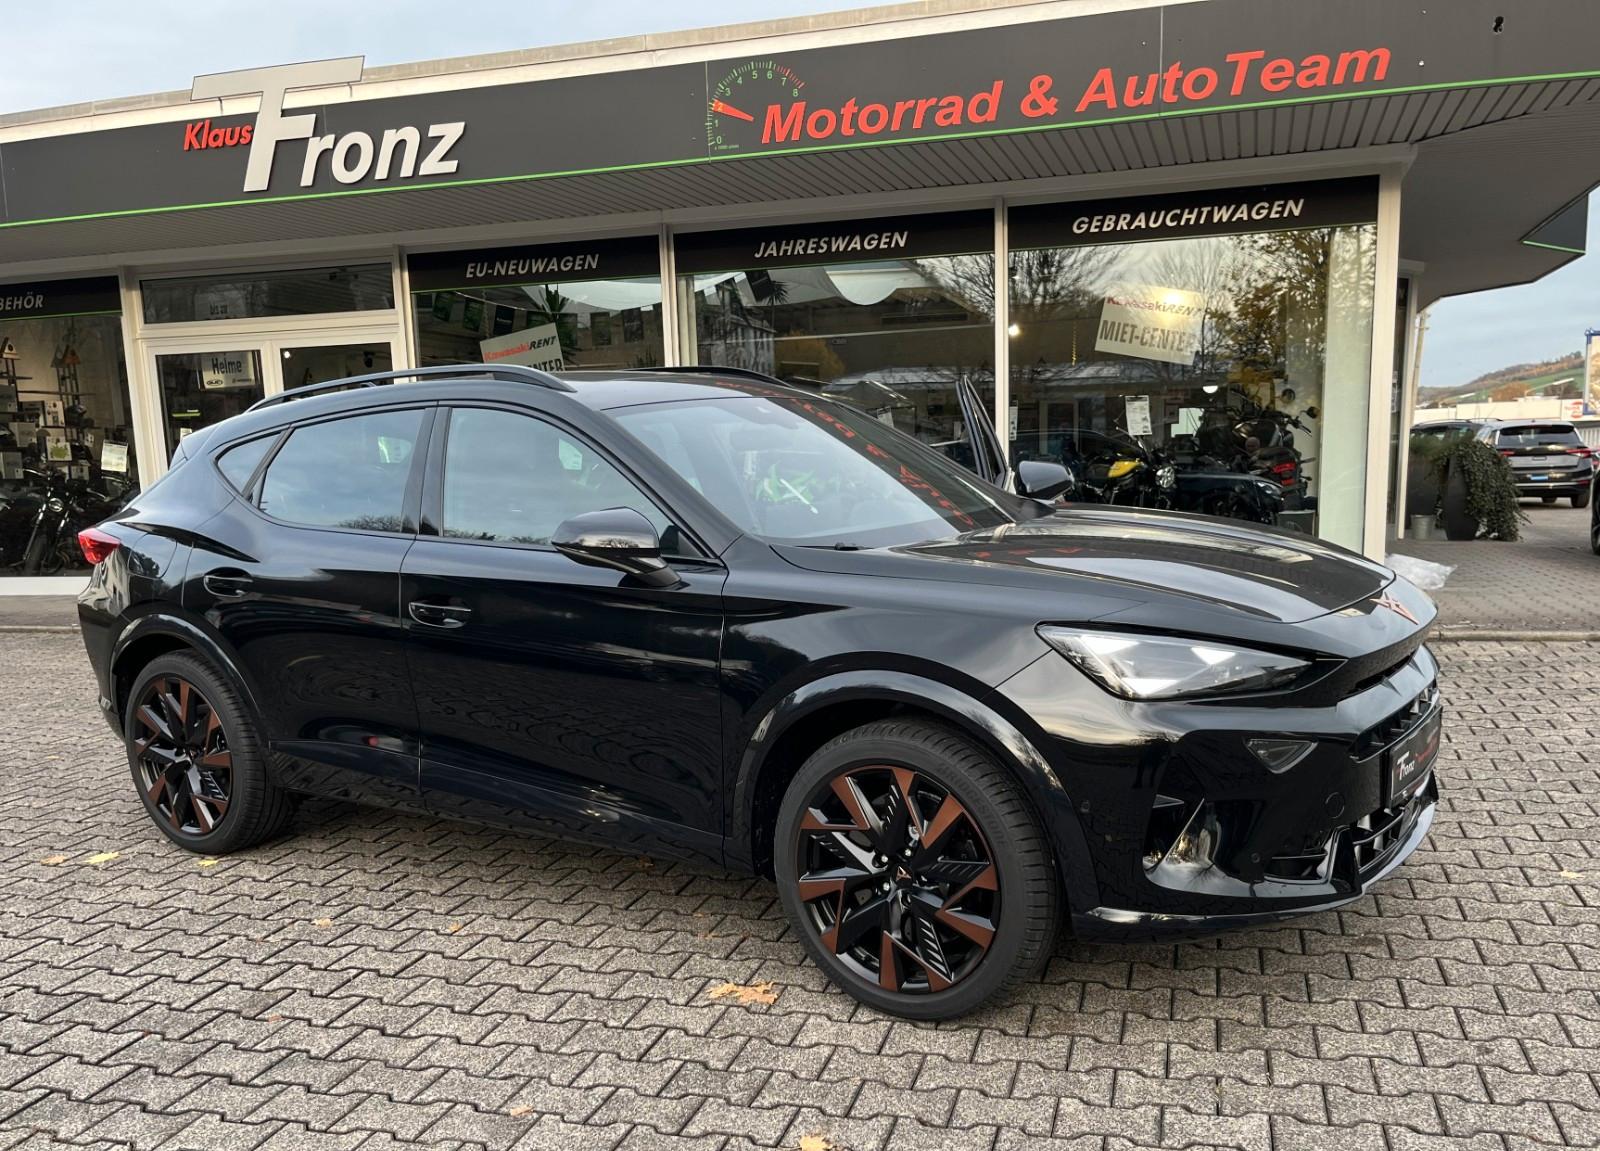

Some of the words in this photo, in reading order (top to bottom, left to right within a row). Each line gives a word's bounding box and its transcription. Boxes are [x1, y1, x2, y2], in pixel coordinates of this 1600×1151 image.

[190, 55, 465, 193] Fronz
[761, 80, 1004, 145] Motorrad
[1021, 74, 1058, 118] &
[184, 119, 254, 151] Klaus
[1072, 199, 1304, 234] GEBRAUCHTWAGEN
[754, 231, 909, 258] JAHRESWAGEN
[466, 254, 599, 278] EU-NEUWAGEN
[211, 357, 242, 375] Helme
